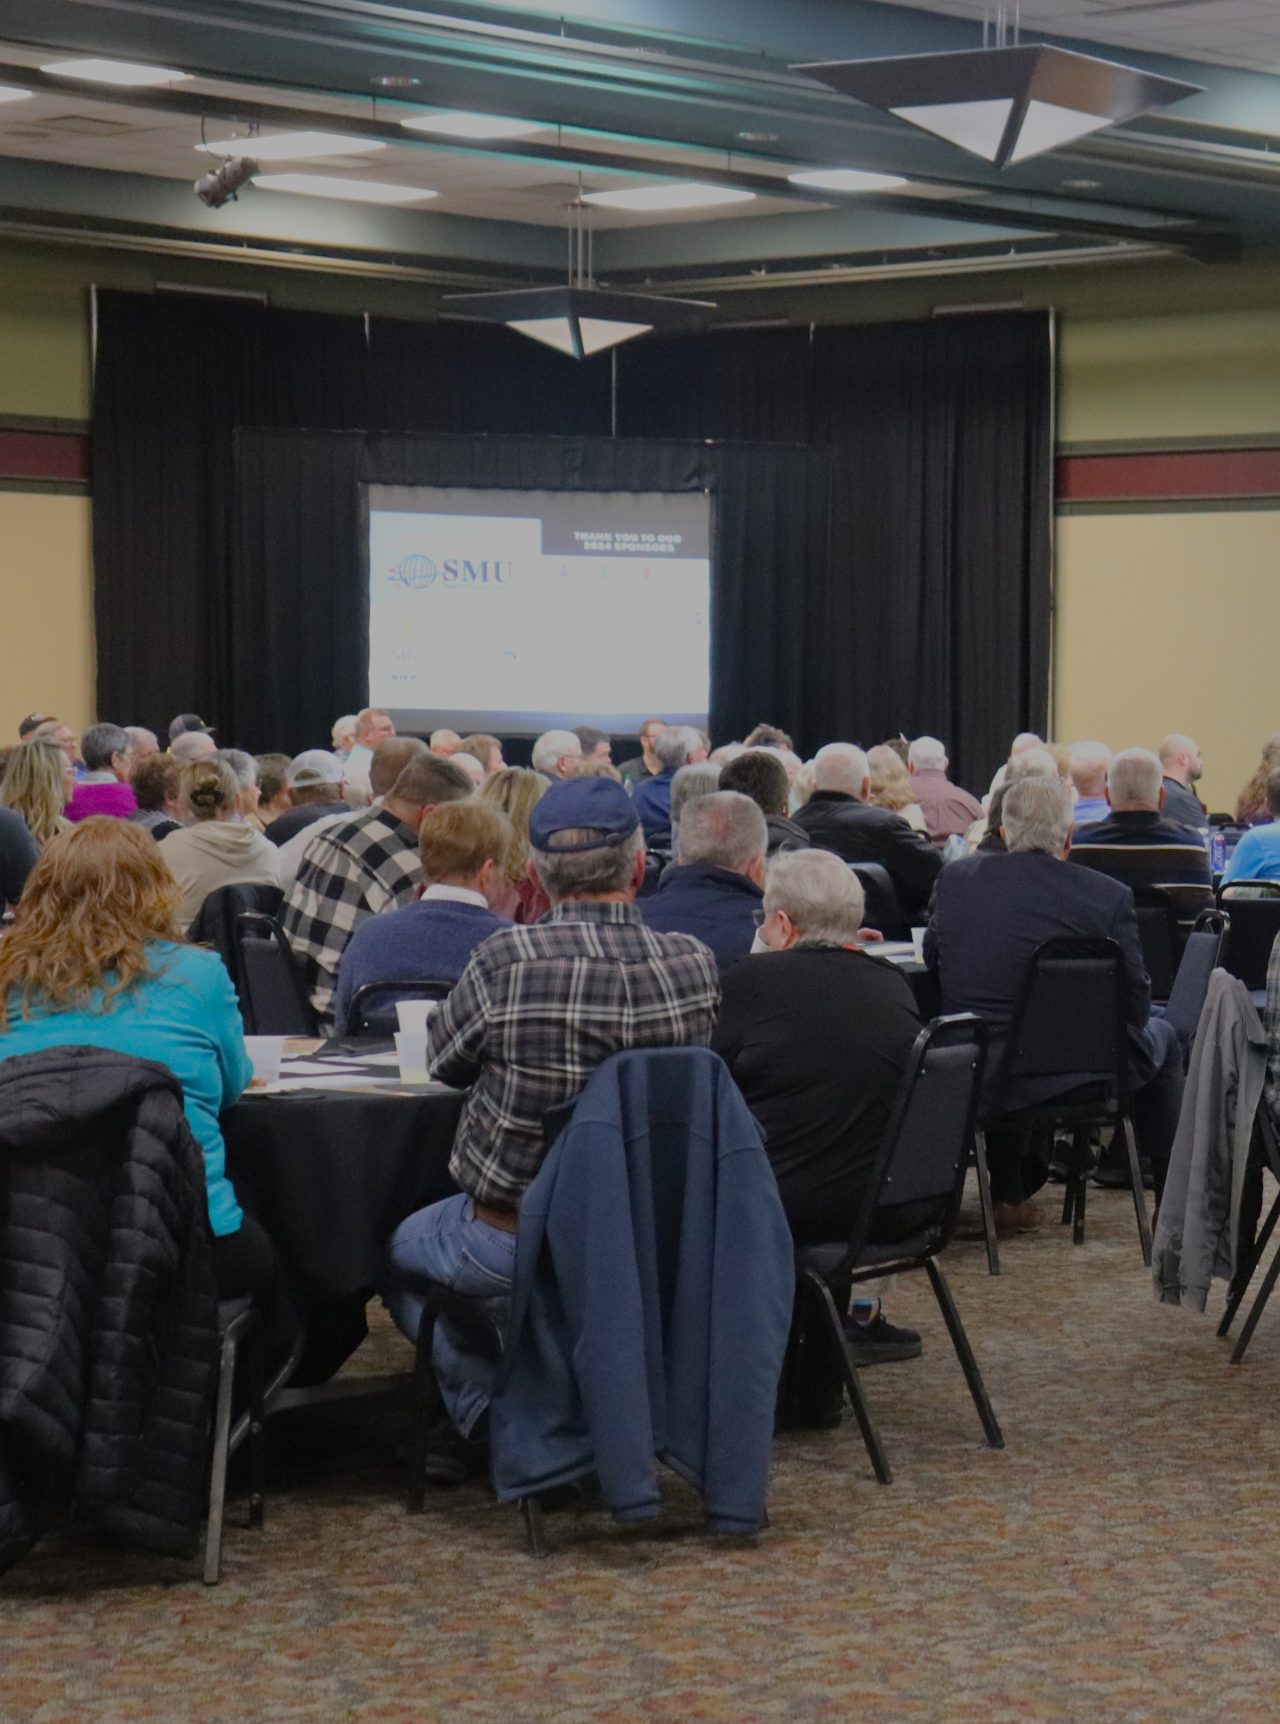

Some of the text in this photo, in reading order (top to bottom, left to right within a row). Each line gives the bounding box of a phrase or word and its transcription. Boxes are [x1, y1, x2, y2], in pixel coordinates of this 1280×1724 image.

[574, 531, 682, 543] THANK YOU TO OUR
[614, 542, 675, 552] SPONSORS
[443, 559, 512, 582] SMU
